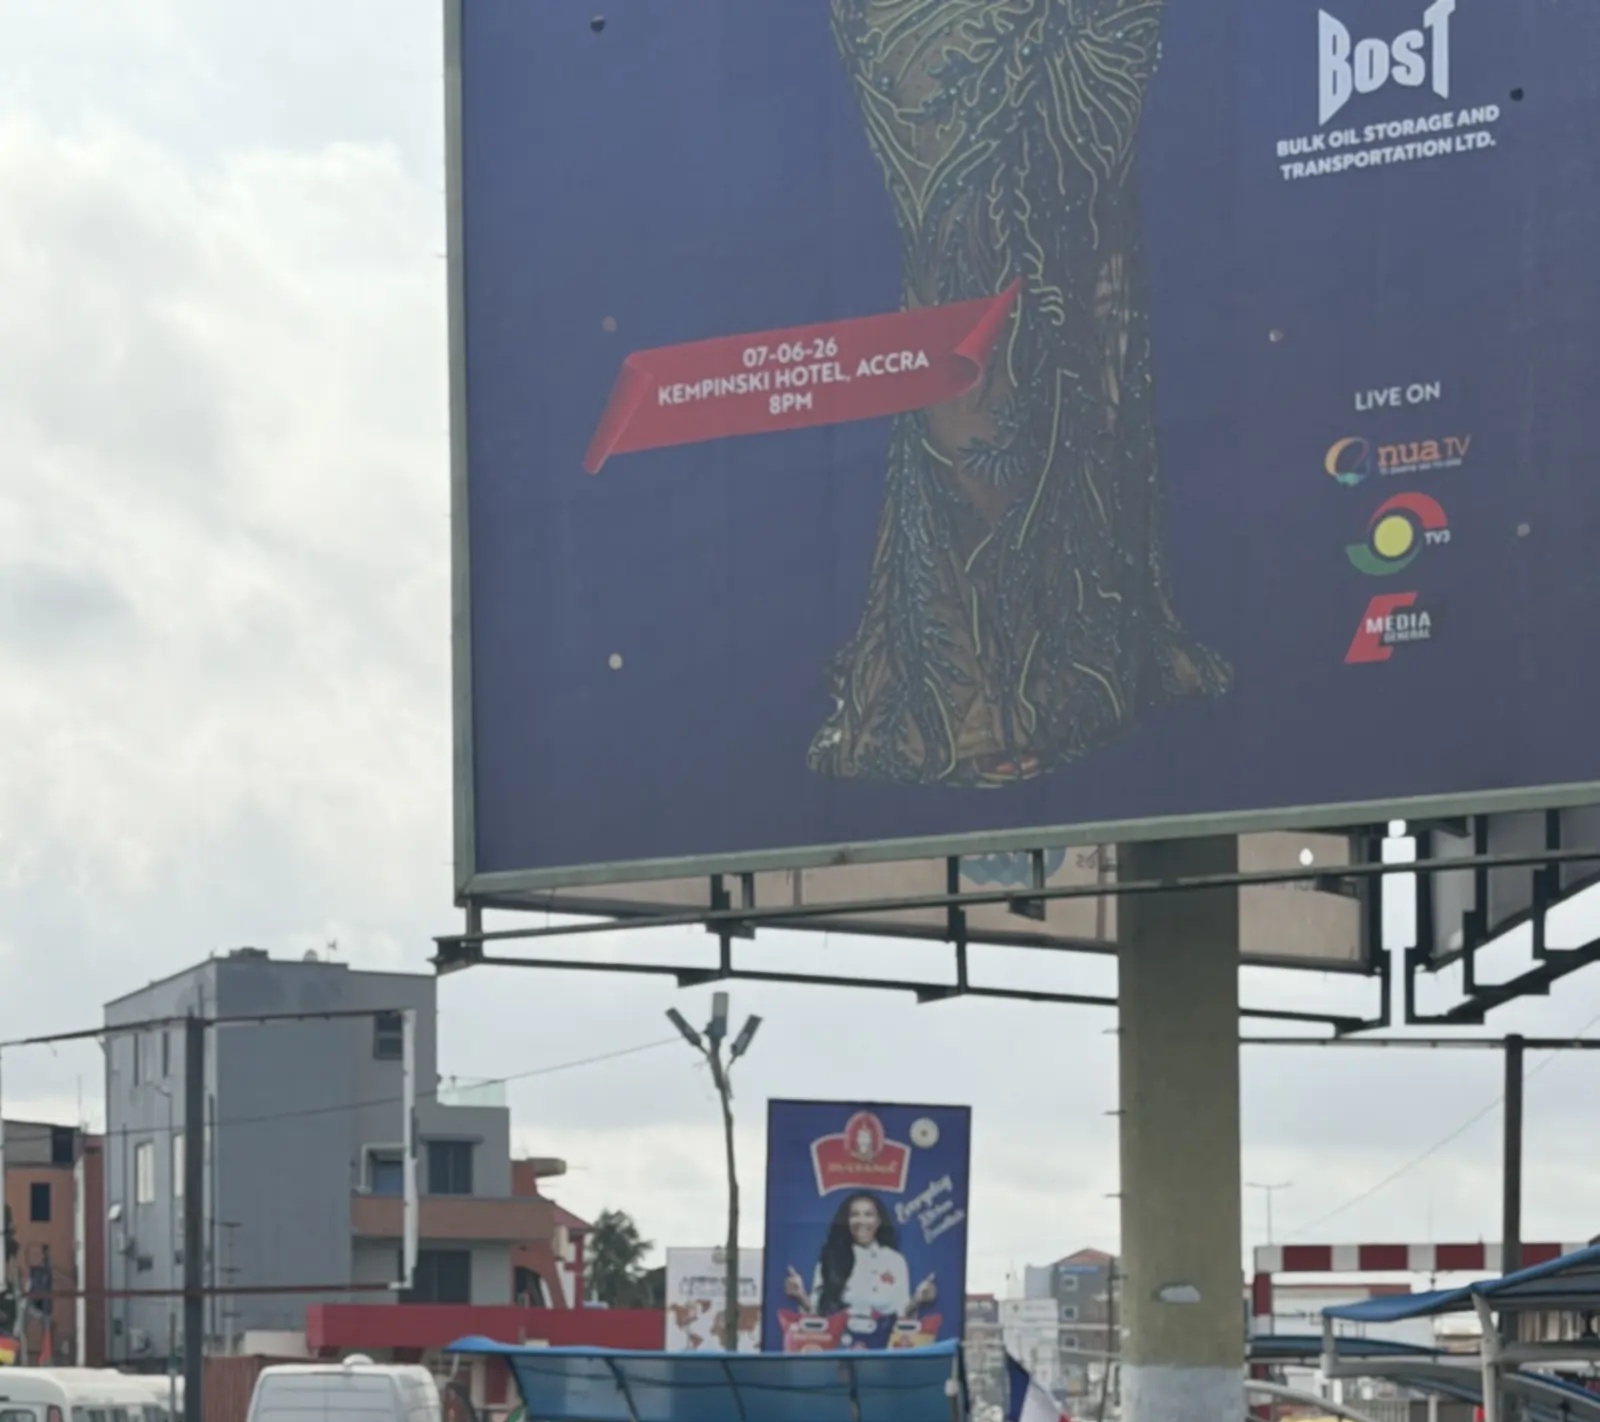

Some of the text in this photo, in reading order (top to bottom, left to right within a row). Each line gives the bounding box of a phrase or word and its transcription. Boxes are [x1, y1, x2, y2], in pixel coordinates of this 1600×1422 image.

[1276, 104, 1500, 157] BULK OIL STORAGE AND
[1280, 131, 1496, 180] TRANSPORTATION LTD.
[742, 337, 838, 368] 07-06-26
[658, 350, 929, 406] KEMPINSKI HOTEL, ACCRA
[769, 392, 813, 415] 8PM
[1355, 381, 1441, 411] LIVE ON
[1424, 529, 1451, 545] TV3
[1366, 611, 1431, 634] MEDIA
[1384, 628, 1430, 643] GENERAL
